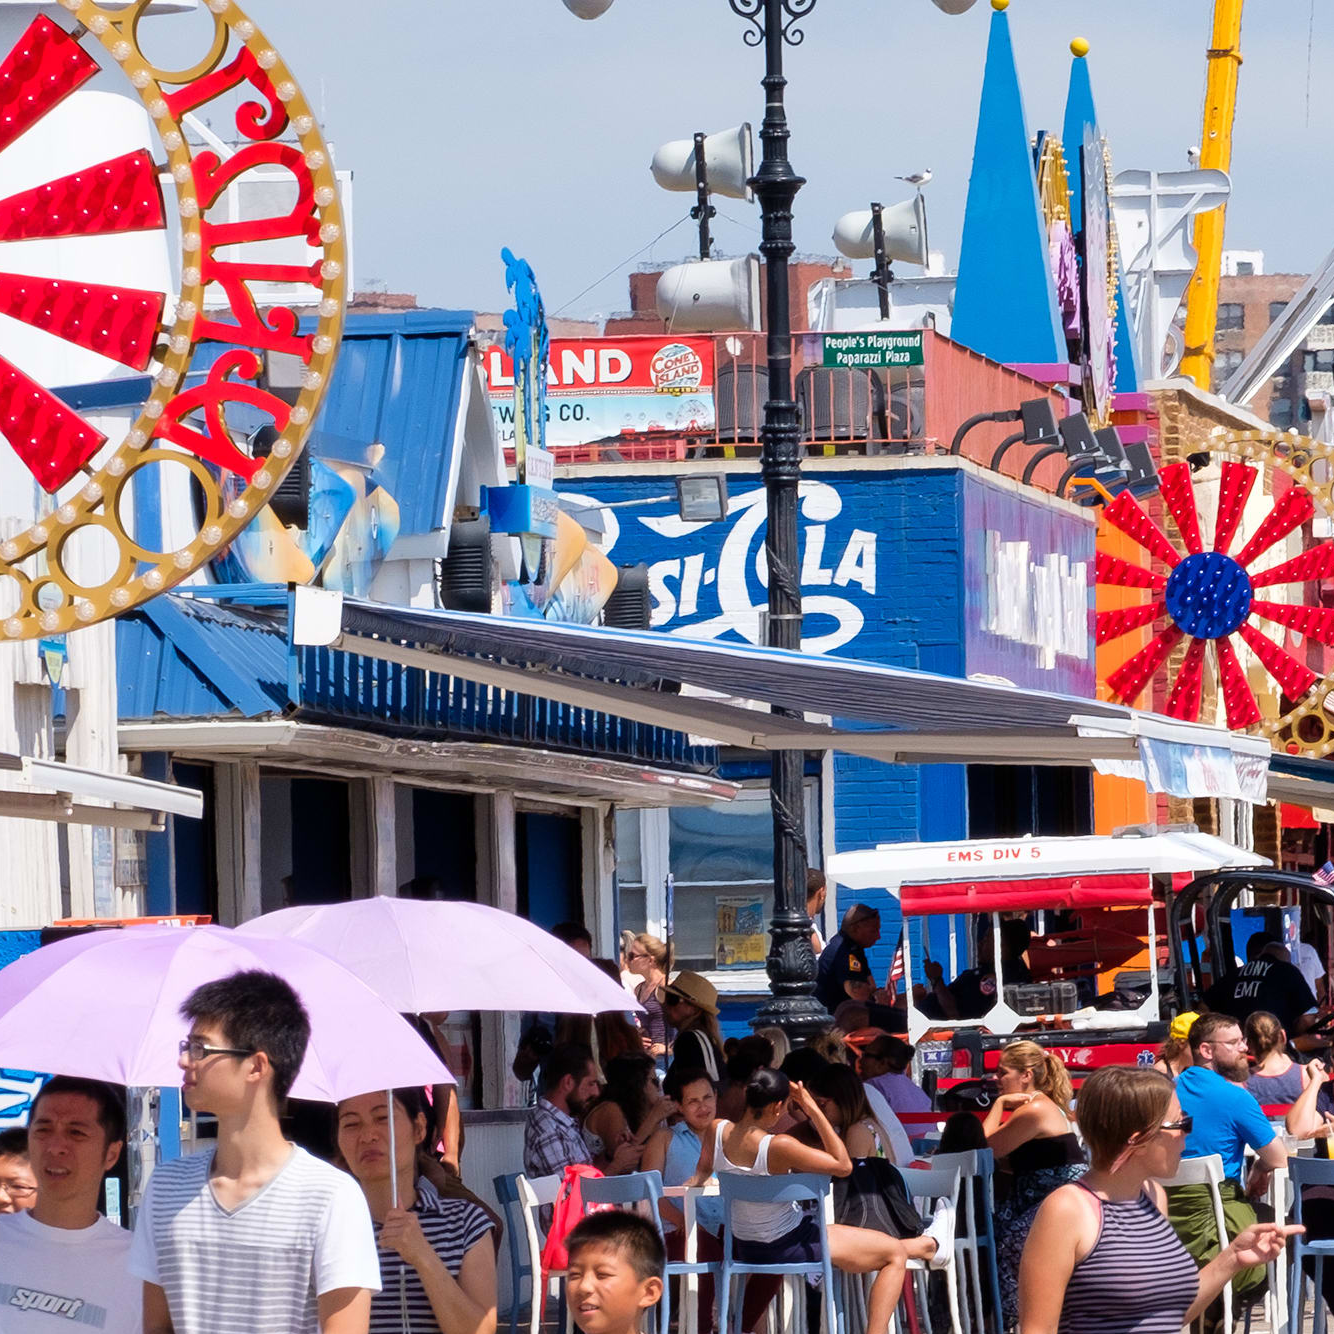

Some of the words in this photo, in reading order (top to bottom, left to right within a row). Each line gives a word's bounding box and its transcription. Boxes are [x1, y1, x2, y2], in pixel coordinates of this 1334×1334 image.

[825, 335, 865, 350] People's
[867, 334, 921, 350] Playground
[836, 351, 881, 366] Paparazzi
[885, 350, 910, 363] Plaza
[560, 403, 590, 421] CO.
[947, 850, 983, 861] EMS
[994, 848, 1020, 860] DIV
[1031, 847, 1041, 858] 5
[1234, 981, 1262, 998] EMT
[10, 1287, 84, 1319] sport
